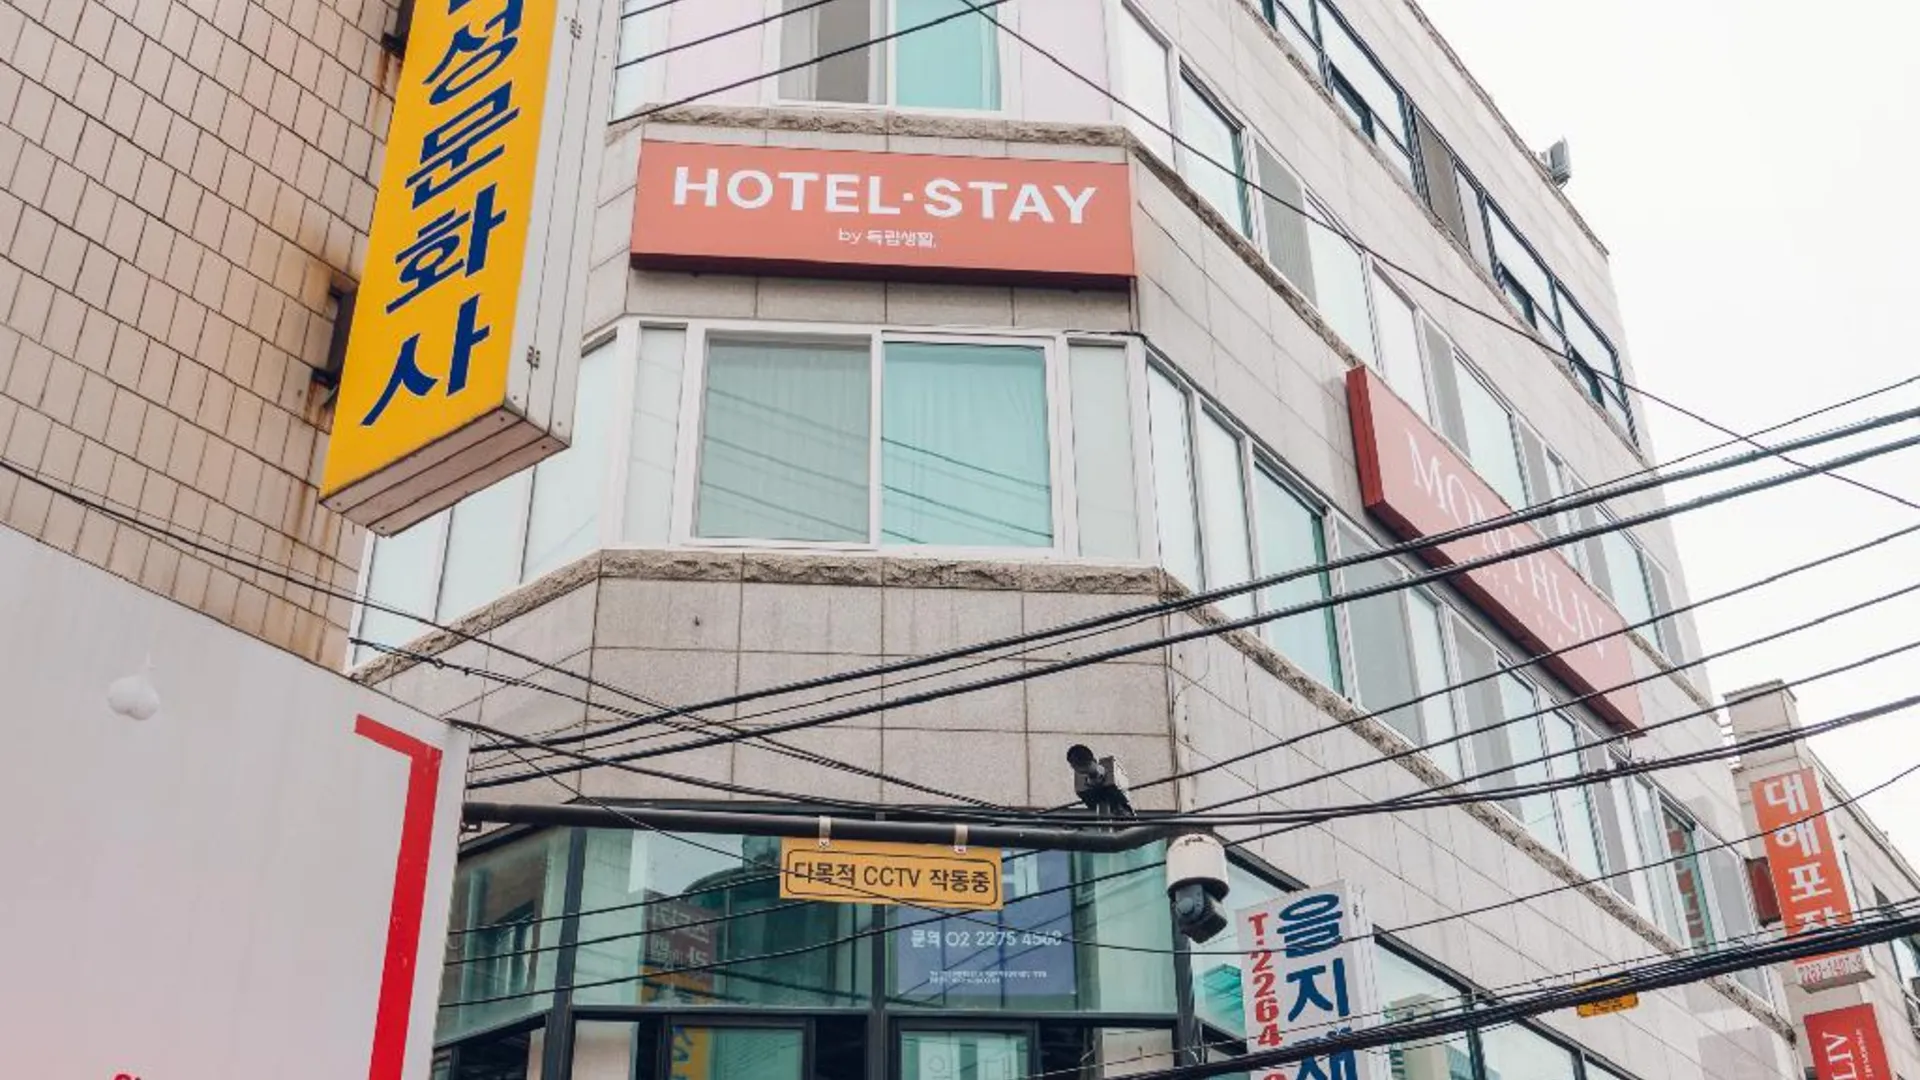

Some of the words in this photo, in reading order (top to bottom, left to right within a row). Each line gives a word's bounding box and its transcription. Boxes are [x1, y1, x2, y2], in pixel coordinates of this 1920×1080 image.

[361, 0, 523, 426] 성문화사
[839, 228, 862, 244] by
[794, 861, 856, 886] 다목적
[863, 865, 921, 888] CCTV
[930, 868, 991, 894] 작동중
[945, 931, 970, 947] 02
[976, 931, 1017, 947] 2275
